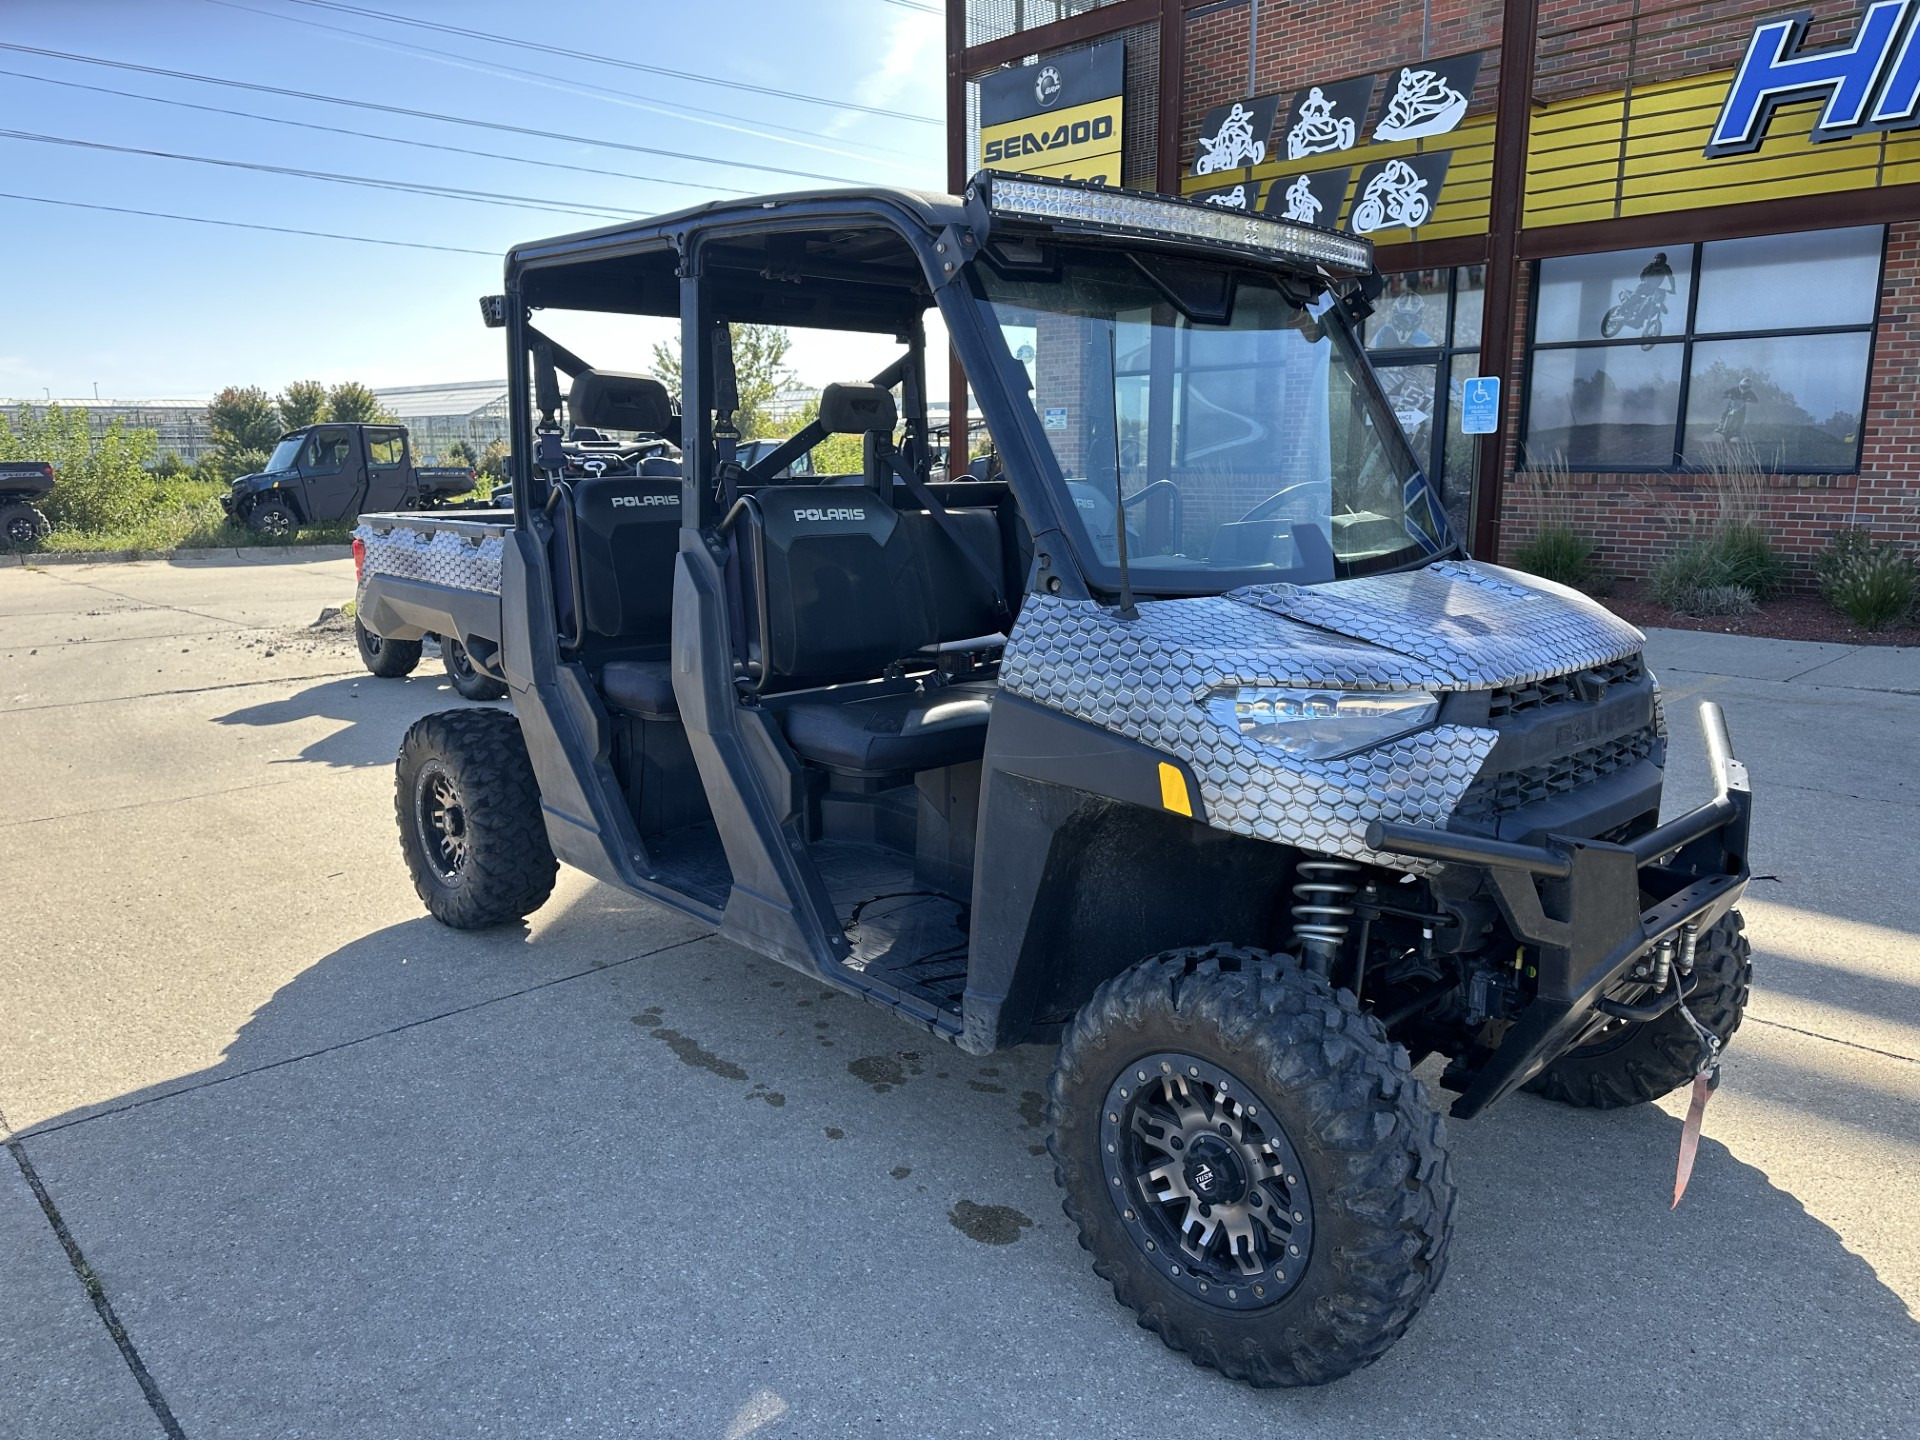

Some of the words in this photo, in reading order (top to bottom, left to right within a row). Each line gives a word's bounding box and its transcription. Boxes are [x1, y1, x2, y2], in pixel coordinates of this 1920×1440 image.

[1045, 84, 1061, 95] BRP
[611, 494, 680, 508] POLARIS
[794, 508, 865, 522] POLARIS
[1194, 1171, 1214, 1184] TUSK
